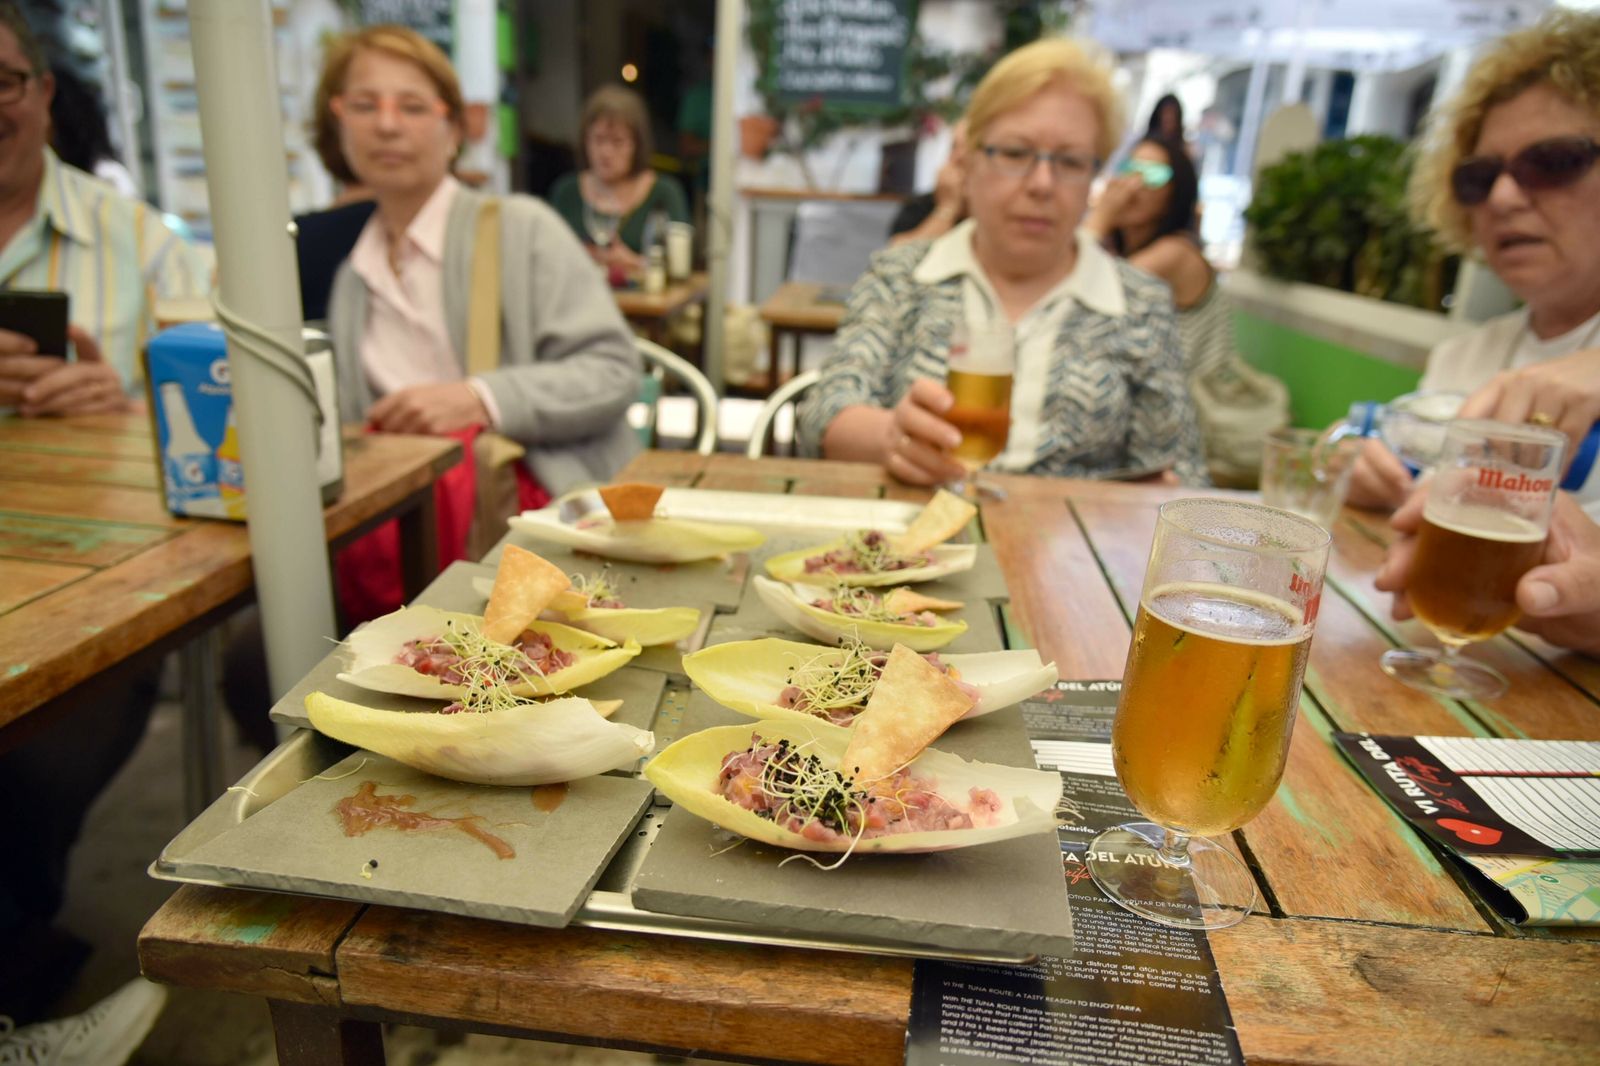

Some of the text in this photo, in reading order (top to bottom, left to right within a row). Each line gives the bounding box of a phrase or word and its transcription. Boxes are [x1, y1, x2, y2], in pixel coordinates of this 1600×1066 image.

[1057, 681, 1086, 691] DEL
[1382, 761, 1426, 797] RUTA
[1061, 851, 1080, 862] TA
[1085, 851, 1120, 862] DEL
[1068, 893, 1091, 901] OTIVO
[1093, 896, 1114, 904] PARA
[1078, 912, 1111, 920] visitantes
[1115, 916, 1142, 924] nuestra
[1107, 910, 1134, 918] ciudad
[1097, 925, 1121, 934] Negra
[1170, 936, 1194, 944] pesca
[1098, 938, 1122, 946] aguas
[1170, 940, 1196, 948] cuatro
[1097, 942, 1116, 950] estos
[1165, 951, 1200, 961] animales
[1063, 958, 1082, 966] para
[1086, 960, 1118, 969] disfrutar
[1161, 970, 1182, 979] junto
[1014, 970, 1056, 982] identidad.
[1066, 971, 1094, 979] cultura
[1075, 964, 1098, 974] punta
[1181, 978, 1208, 987] donde
[968, 984, 986, 992] TUNA
[1046, 996, 1076, 1006] REASON
[1116, 1004, 1142, 1012] TARIFA
[942, 1002, 965, 1011] nomic
[967, 1006, 992, 1015] culture
[995, 1010, 1010, 1018] that
[1012, 1013, 1037, 1022] makes
[942, 995, 958, 1003] With
[975, 1000, 994, 1008] TUNA
[997, 1003, 1020, 1012] ROUTE
[1023, 1007, 1042, 1015] Tarifa
[1045, 1010, 1066, 1018] wants
[1099, 1016, 1121, 1025] locals
[1123, 1020, 1138, 1028] and
[1140, 1022, 1164, 1031] visitors
[1181, 1028, 1195, 1036] rich
[941, 1018, 957, 1026] and
[942, 1010, 960, 1018] Tuna
[1008, 1020, 1032, 1029] called
[1040, 1024, 1058, 1032] Pata
[1060, 1027, 1082, 1037] Negra
